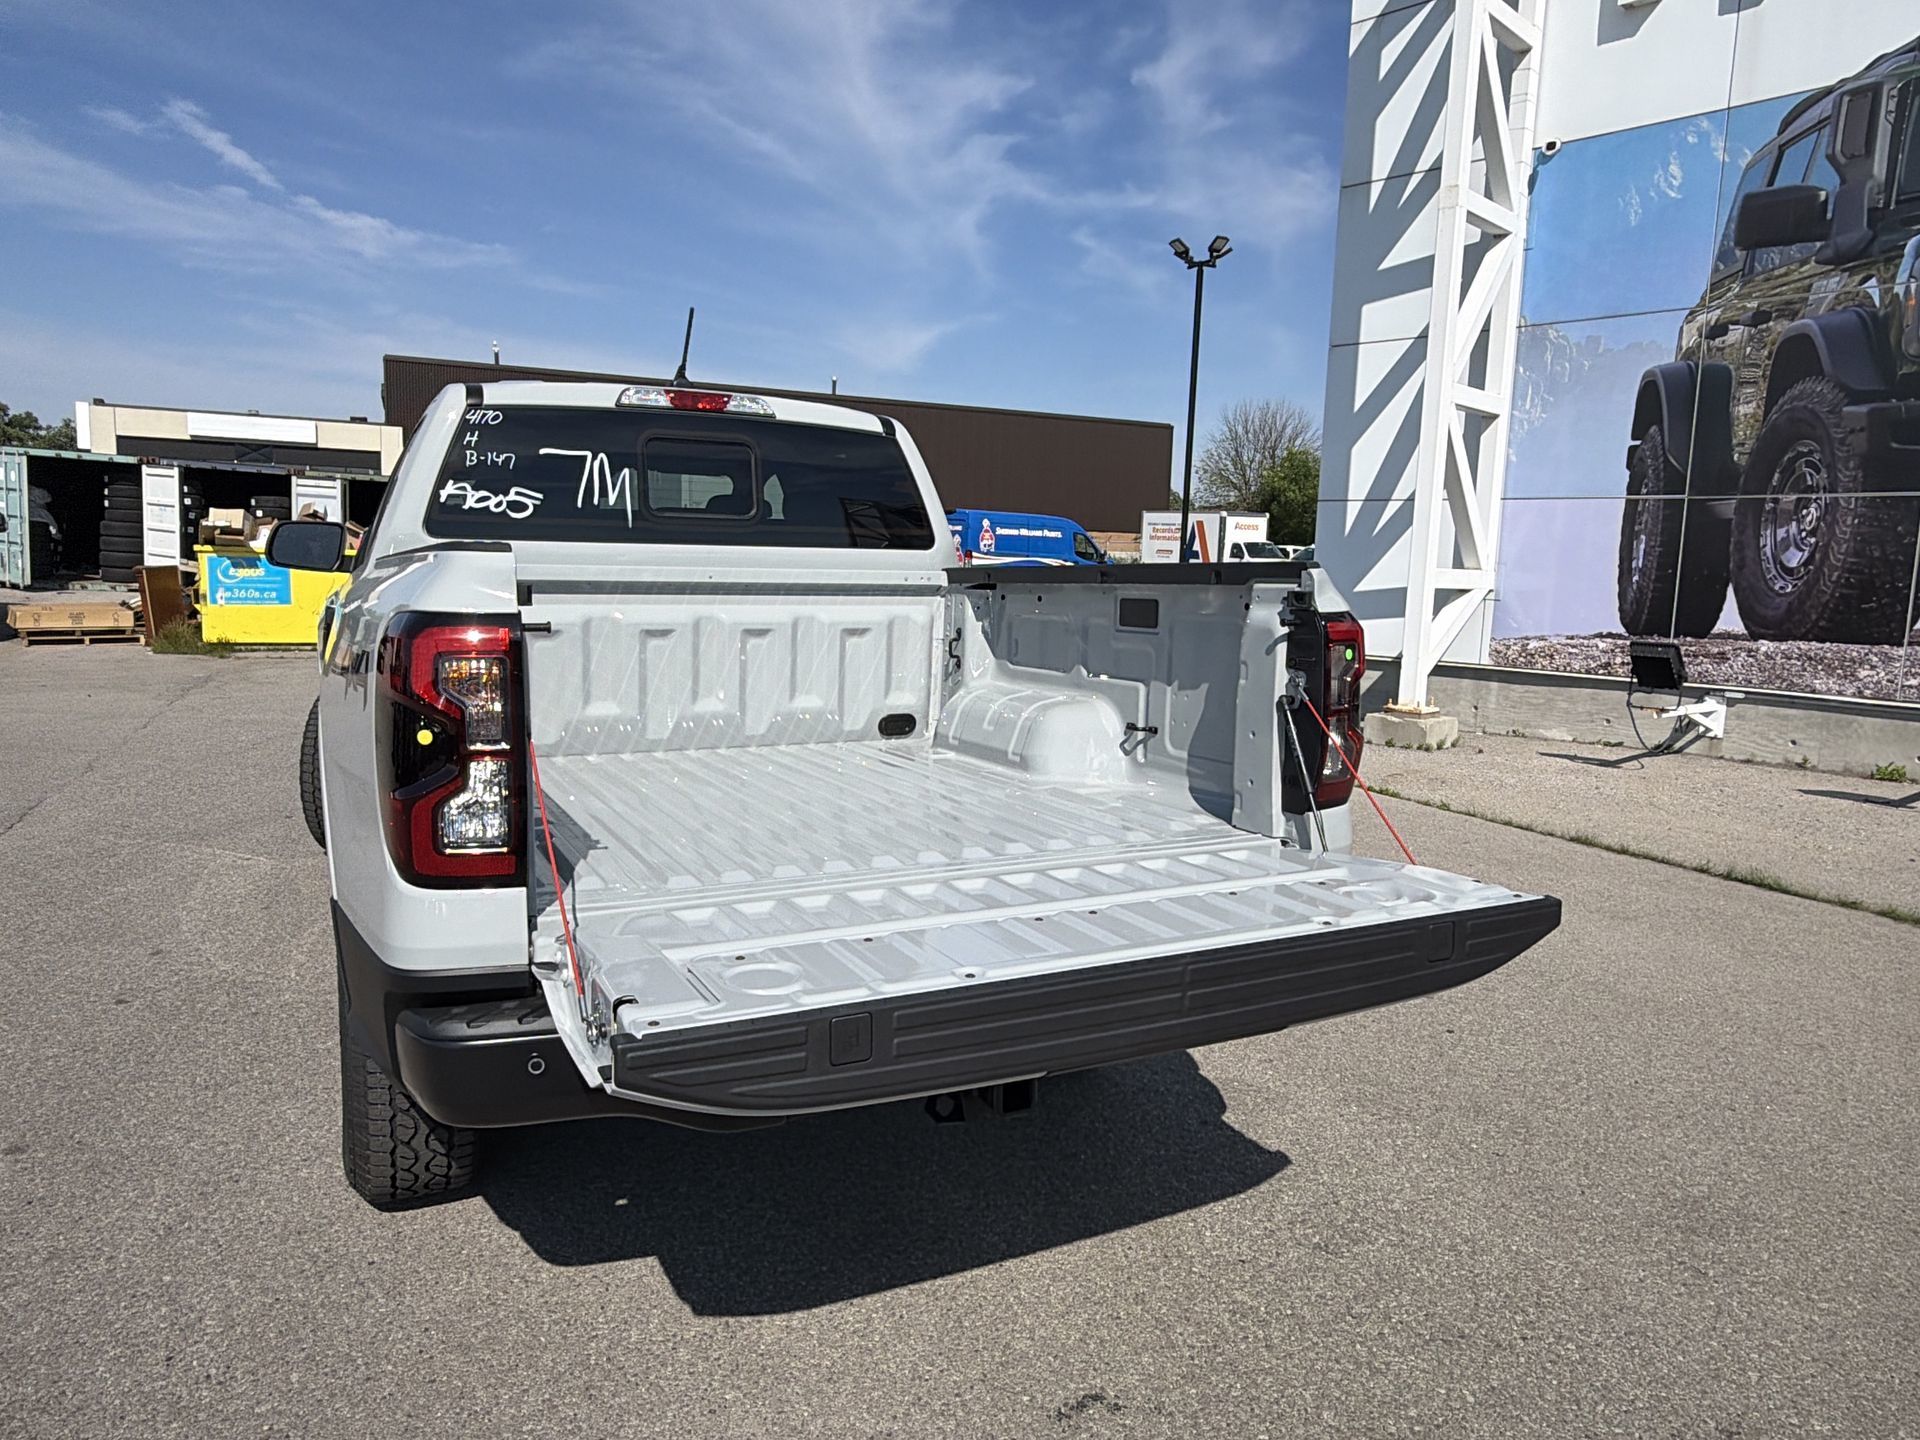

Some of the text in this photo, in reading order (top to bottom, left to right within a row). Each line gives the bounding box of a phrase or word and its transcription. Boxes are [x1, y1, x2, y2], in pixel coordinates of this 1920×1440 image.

[463, 430, 479, 447] H
[465, 449, 516, 470] B-147
[1234, 522, 1259, 531] Access
